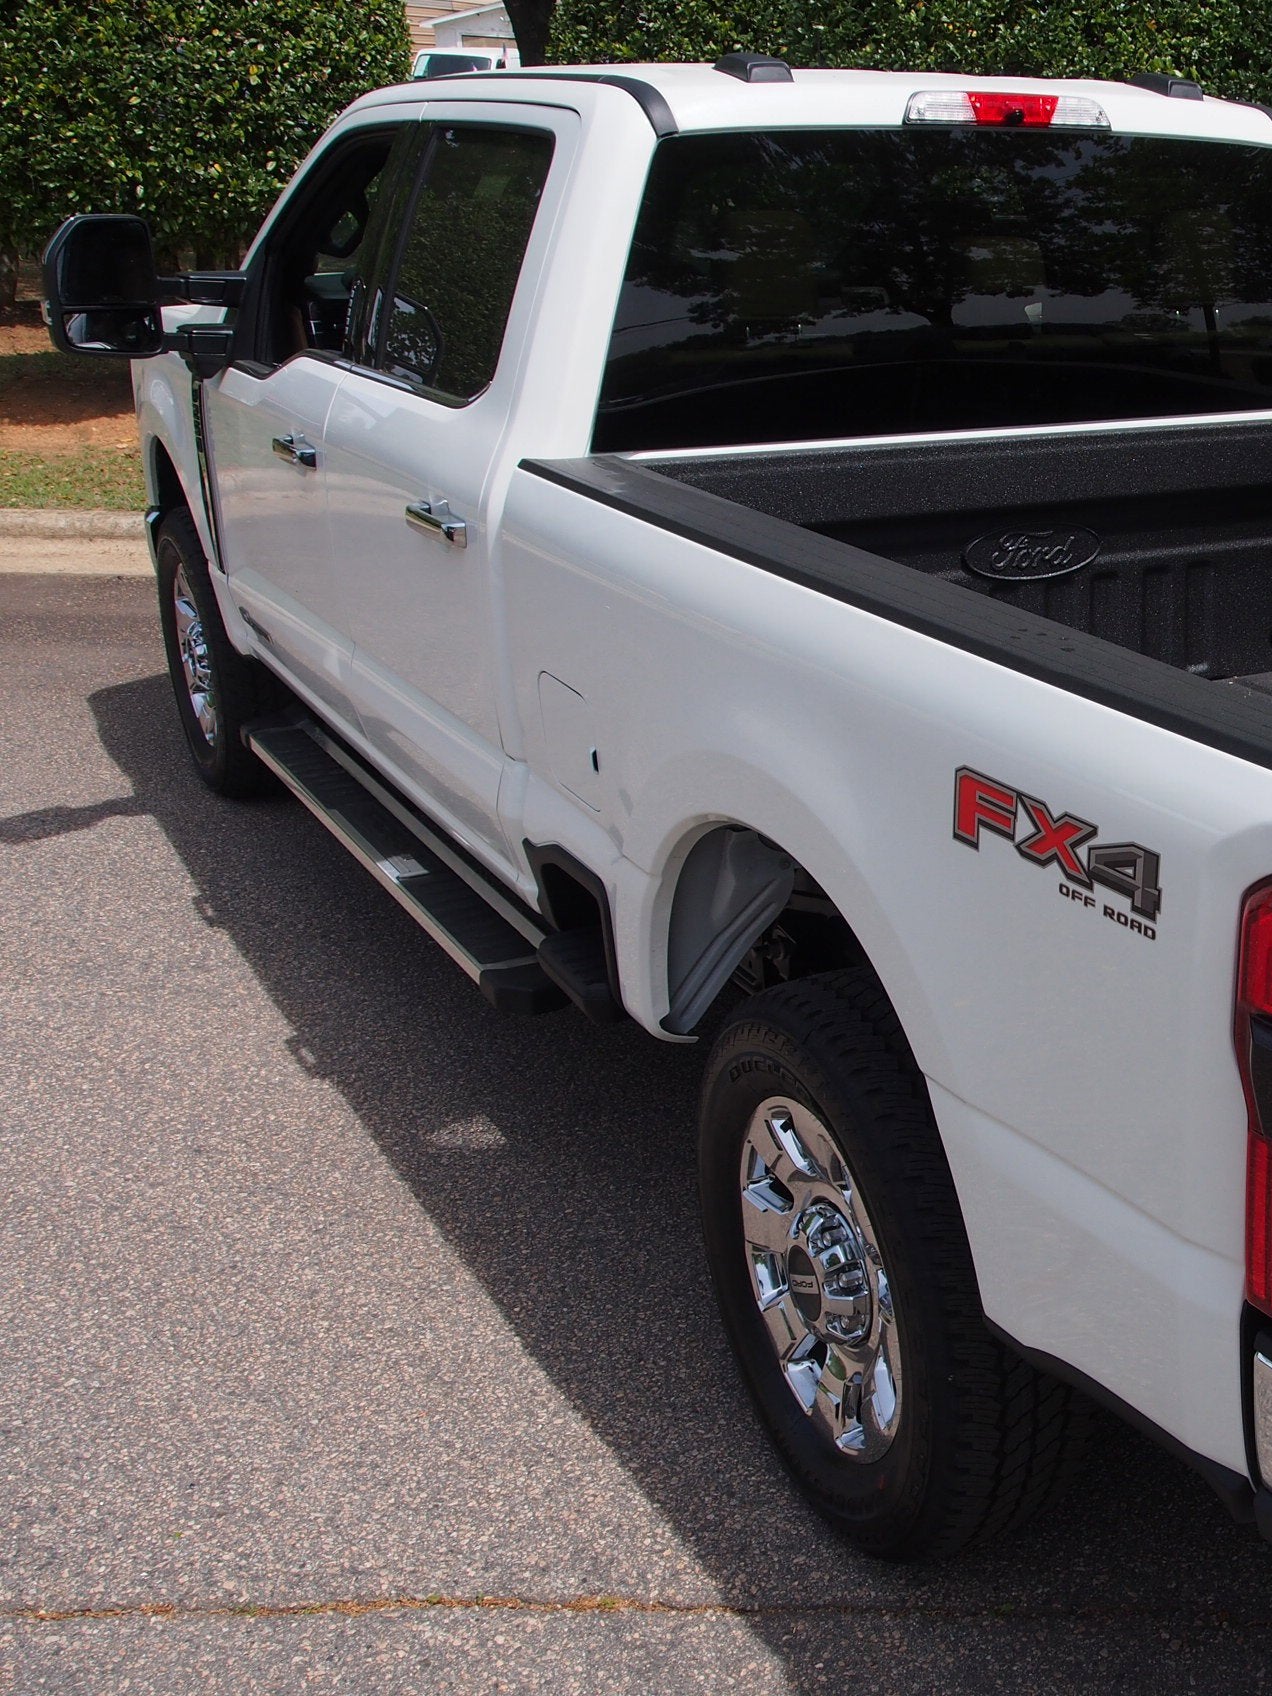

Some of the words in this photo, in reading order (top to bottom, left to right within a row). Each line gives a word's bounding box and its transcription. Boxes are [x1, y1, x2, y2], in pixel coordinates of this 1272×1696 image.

[991, 530, 1075, 570] Ford
[952, 764, 1162, 924] FX4
[1058, 882, 1096, 909] OFF
[1103, 904, 1157, 941] ROAD
